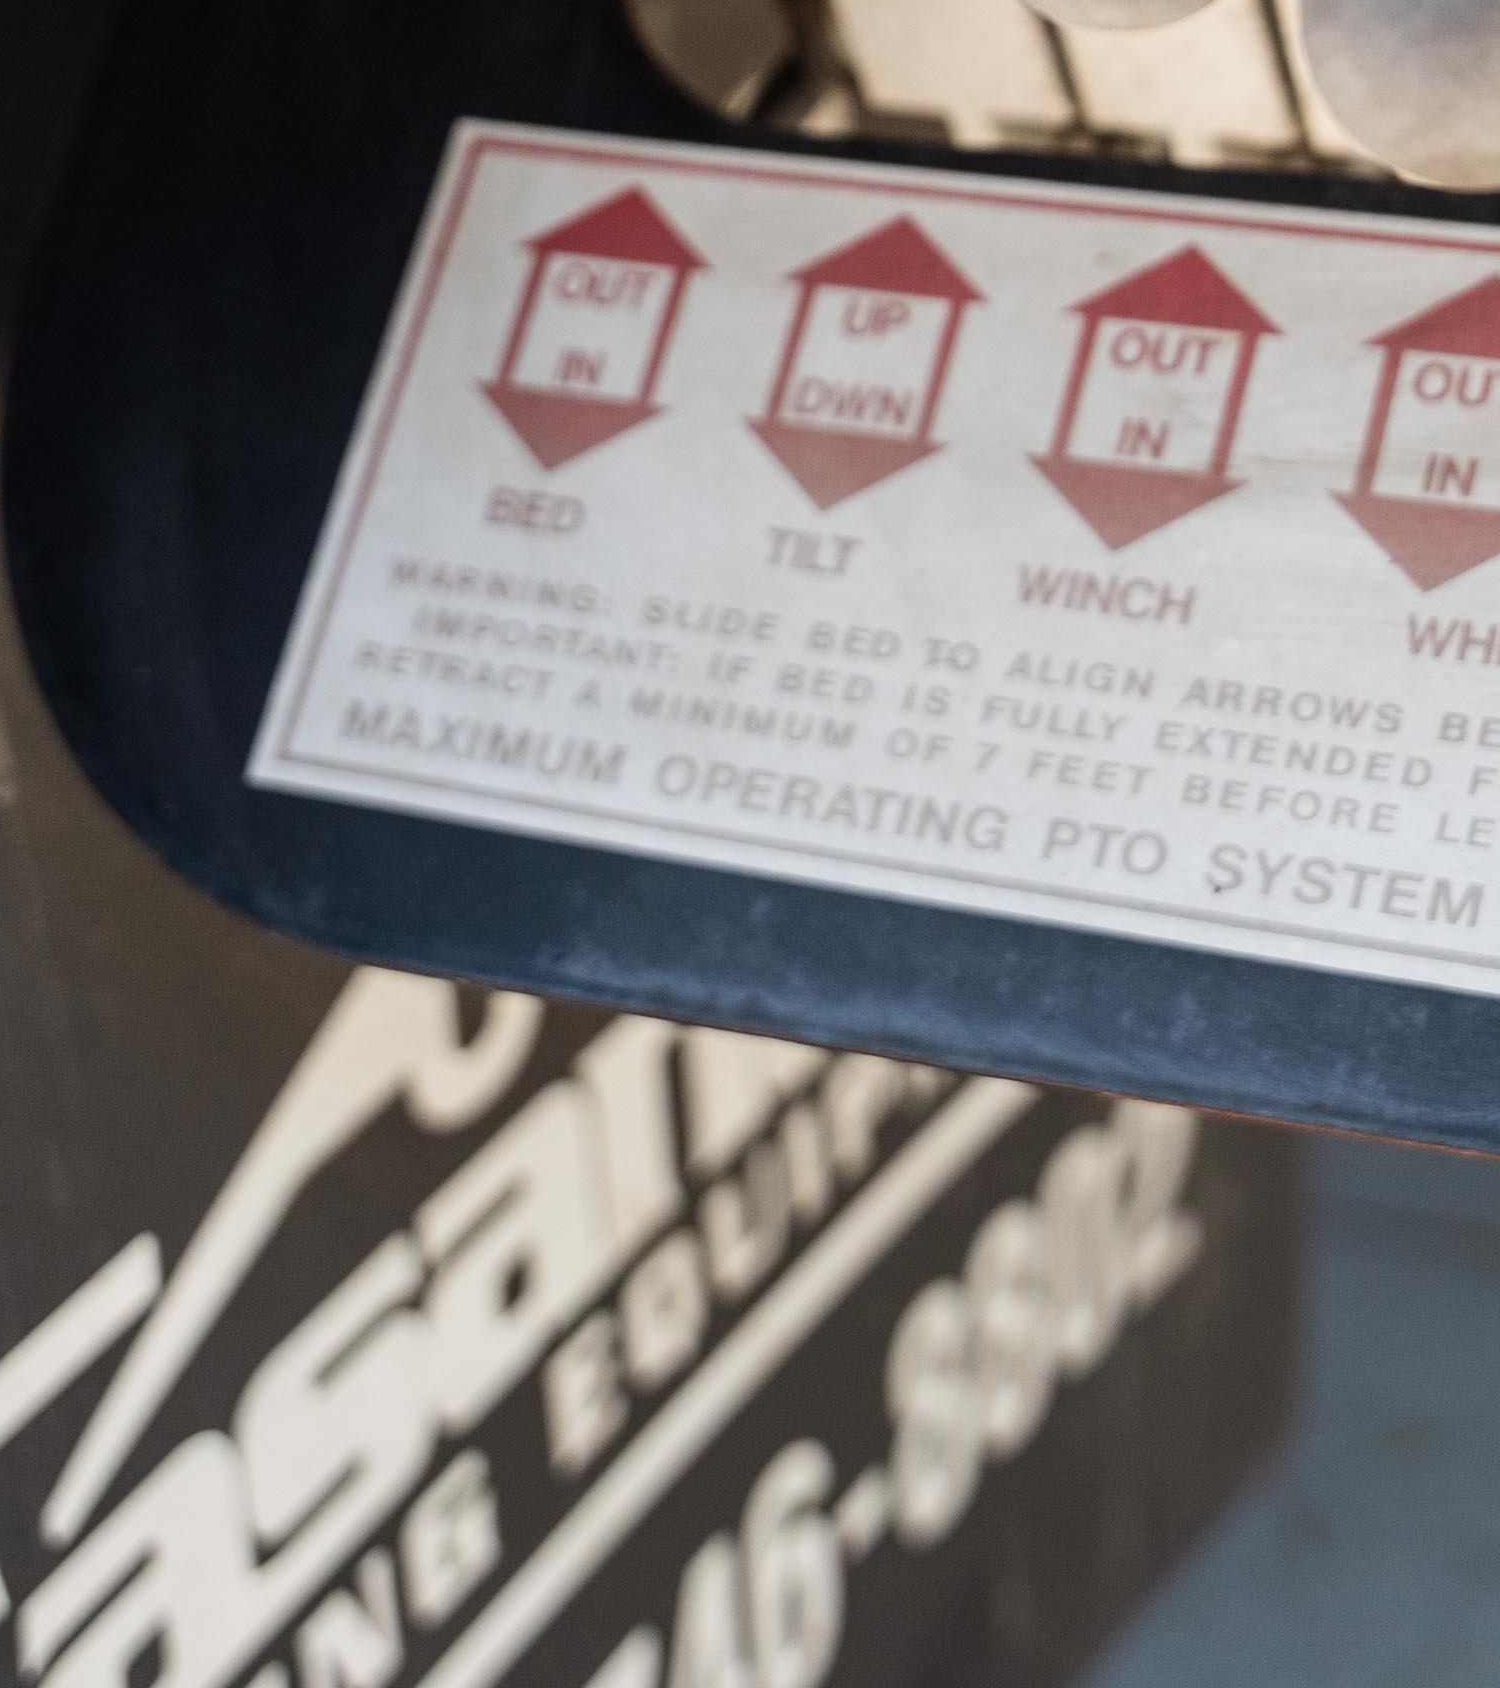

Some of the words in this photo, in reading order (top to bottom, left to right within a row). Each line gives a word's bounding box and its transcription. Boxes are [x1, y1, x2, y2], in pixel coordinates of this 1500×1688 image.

[555, 262, 656, 310] OUT
[841, 296, 914, 340] UP
[554, 348, 609, 387] IN
[1109, 326, 1223, 377] OUT
[792, 375, 917, 427] DWN
[1115, 414, 1171, 461] IN
[1421, 451, 1481, 498] IN
[485, 485, 589, 536] BED
[764, 524, 864, 576] TILT
[1016, 560, 1198, 627] WINCH
[389, 556, 614, 615] WARNING:
[642, 593, 783, 643] SLIDE
[807, 619, 903, 661] BED
[922, 635, 982, 674] TO
[1003, 649, 1159, 701] ALIGN
[1180, 675, 1406, 737] ARROWS
[410, 604, 682, 674] IMPORTANT:
[704, 650, 758, 686] IF
[774, 663, 877, 705] BED
[901, 680, 953, 718] IS
[979, 693, 1128, 745] FULLY
[1153, 718, 1435, 789] EXTENDED
[353, 637, 555, 699] RETRACT
[573, 682, 604, 711] A
[628, 686, 860, 752] MINIMUM
[884, 726, 956, 764] OF
[974, 739, 1003, 774] 7
[1025, 749, 1157, 798] FEET
[1180, 772, 1401, 835] BEFORE
[338, 698, 629, 788] MAXIMUM
[653, 752, 1011, 853] OPERATING
[1042, 815, 1172, 878] PTO
[1202, 842, 1487, 930] SYSTEM
